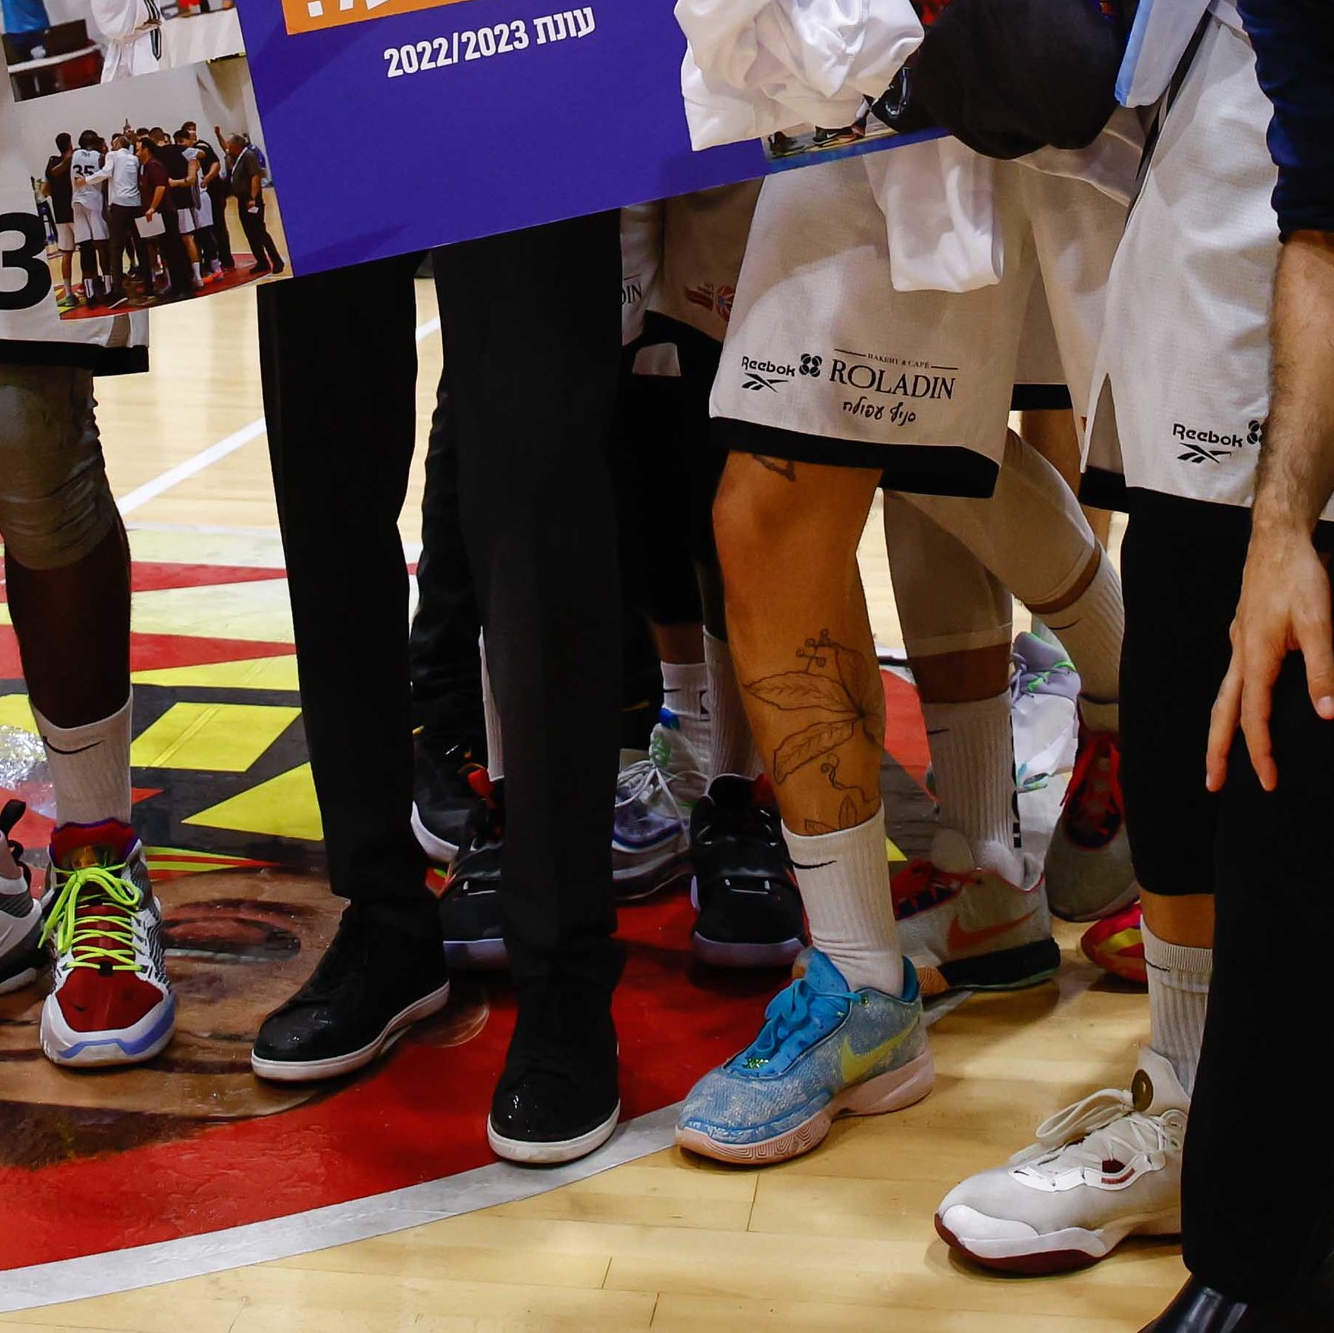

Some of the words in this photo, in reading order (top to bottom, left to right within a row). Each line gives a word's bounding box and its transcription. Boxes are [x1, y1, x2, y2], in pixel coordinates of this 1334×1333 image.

[532, 6, 597, 46] עונת
[383, 20, 530, 78] 2022/2023
[741, 355, 796, 377] Reebok
[829, 358, 957, 400] ROLADIN
[1172, 423, 1244, 448] Reebok
